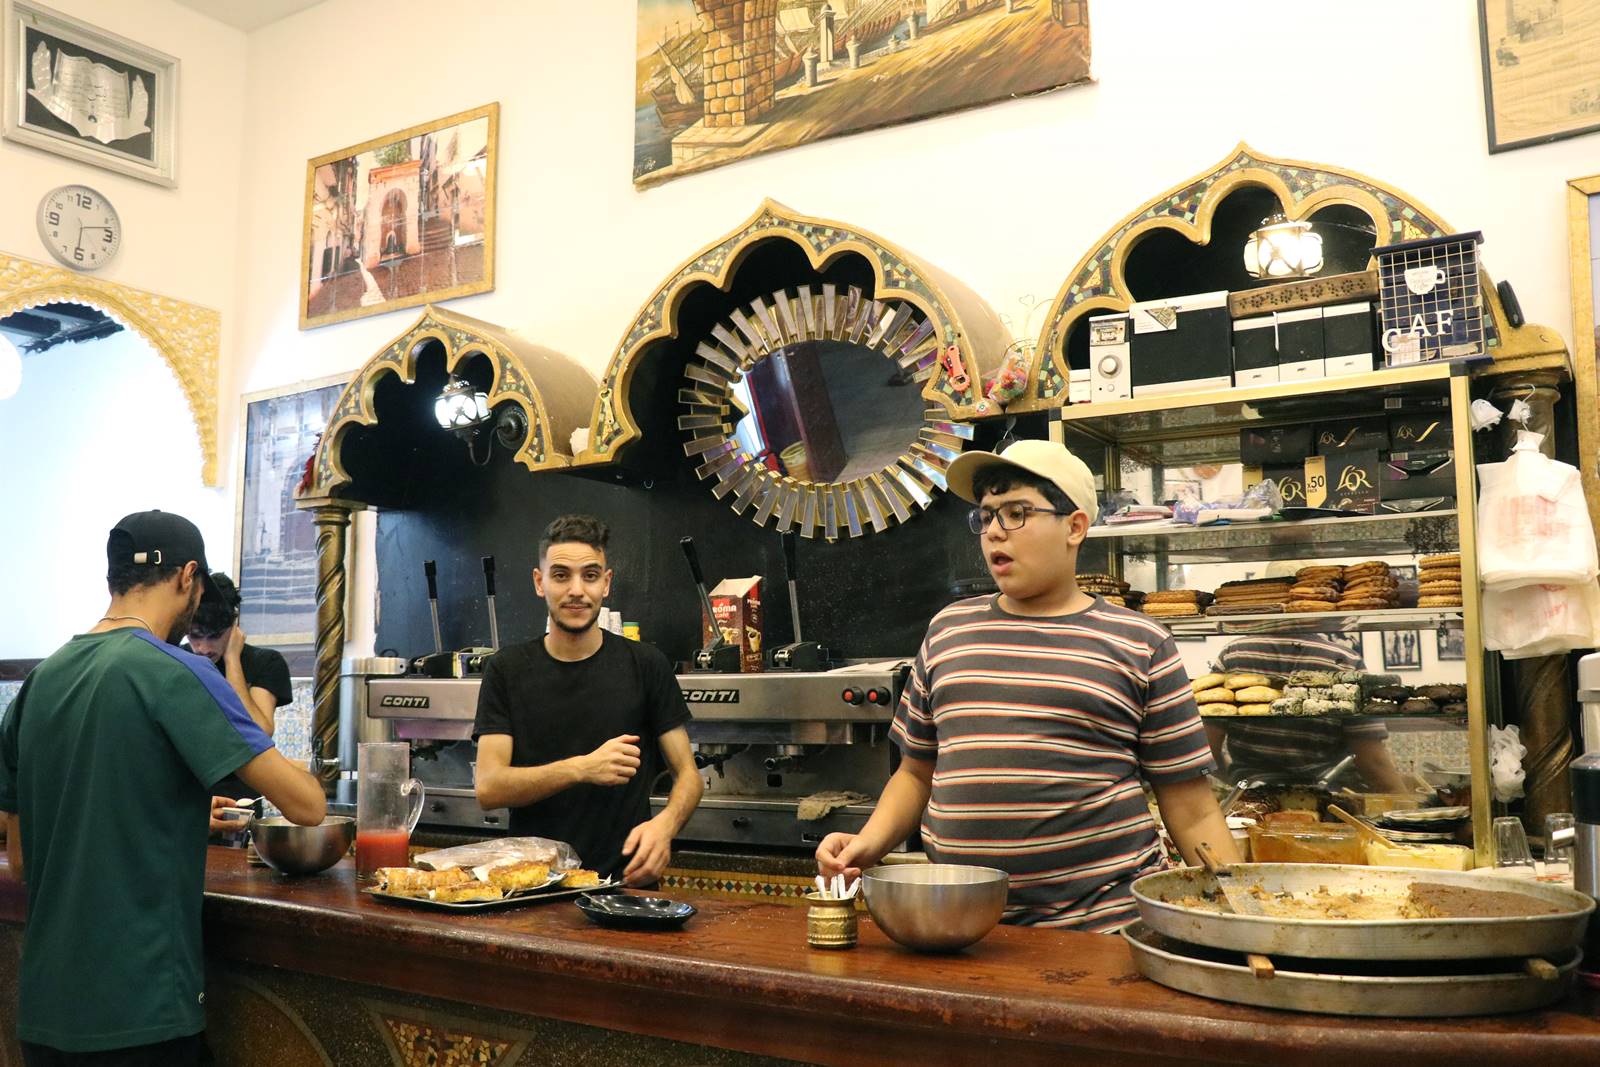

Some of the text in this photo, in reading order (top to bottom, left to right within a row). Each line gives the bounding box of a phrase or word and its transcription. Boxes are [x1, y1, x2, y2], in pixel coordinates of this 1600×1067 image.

[76, 193, 92, 210] 12
[48, 211, 60, 226] 9
[102, 228, 113, 243] 3
[74, 247, 84, 261] 6
[1307, 475, 1325, 489] x50
[1335, 464, 1374, 492] L'OR
[383, 696, 427, 706] CONTI
